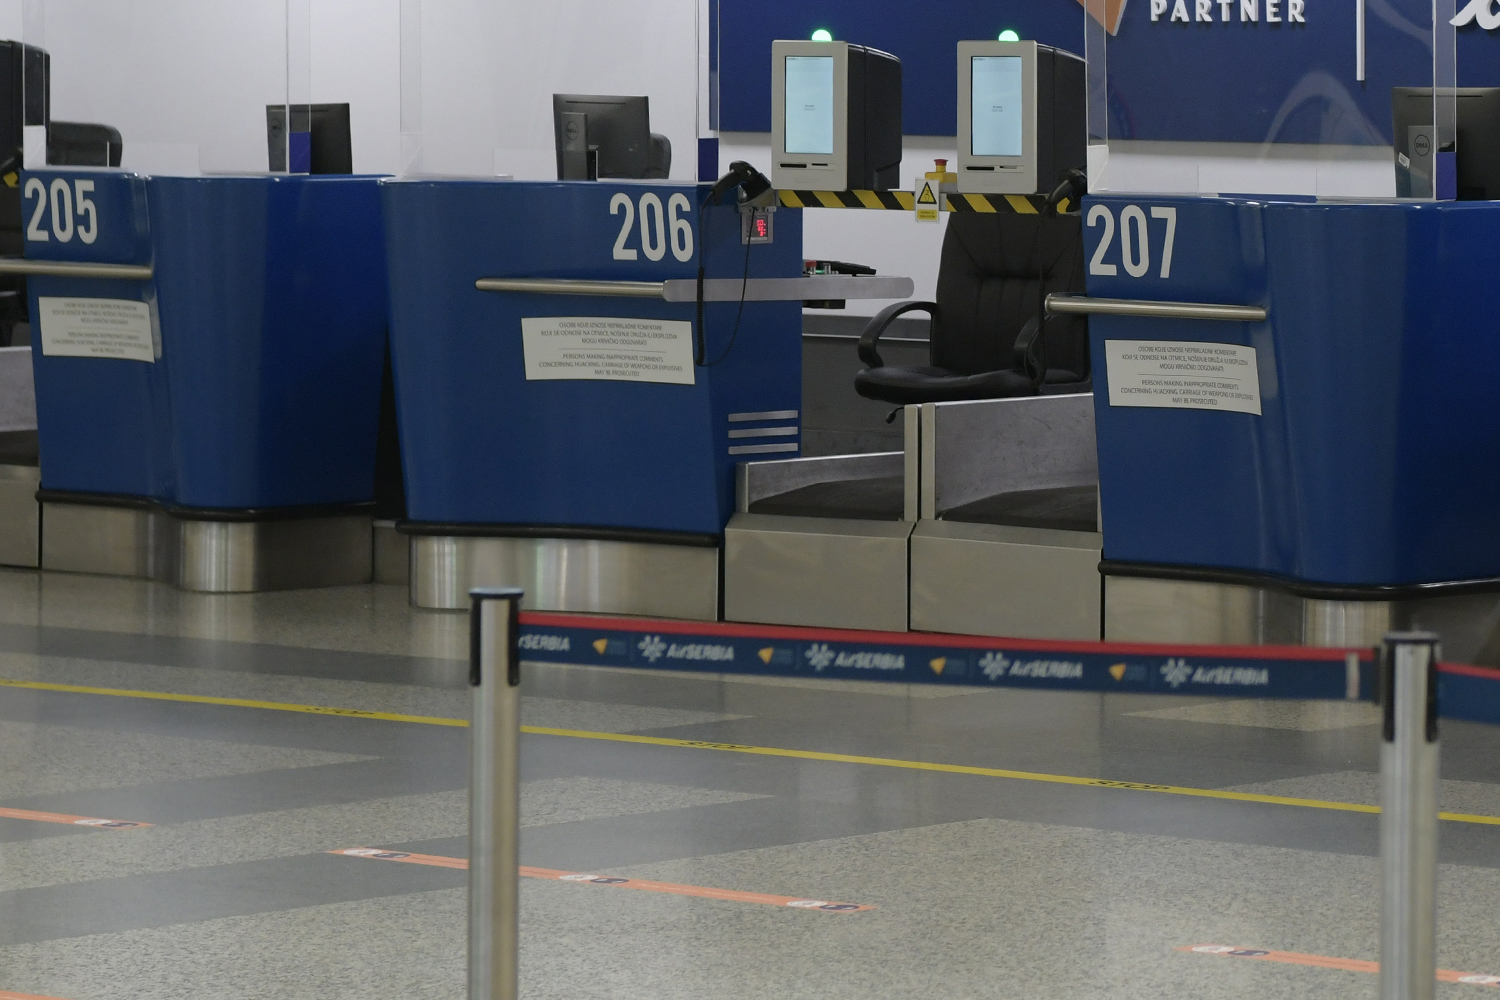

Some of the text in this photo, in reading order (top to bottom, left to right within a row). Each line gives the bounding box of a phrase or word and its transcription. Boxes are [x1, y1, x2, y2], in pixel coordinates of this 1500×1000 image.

[24, 177, 98, 245] 205
[609, 191, 695, 263] 206
[1087, 204, 1177, 279] 207
[518, 634, 570, 652] rSERBIA
